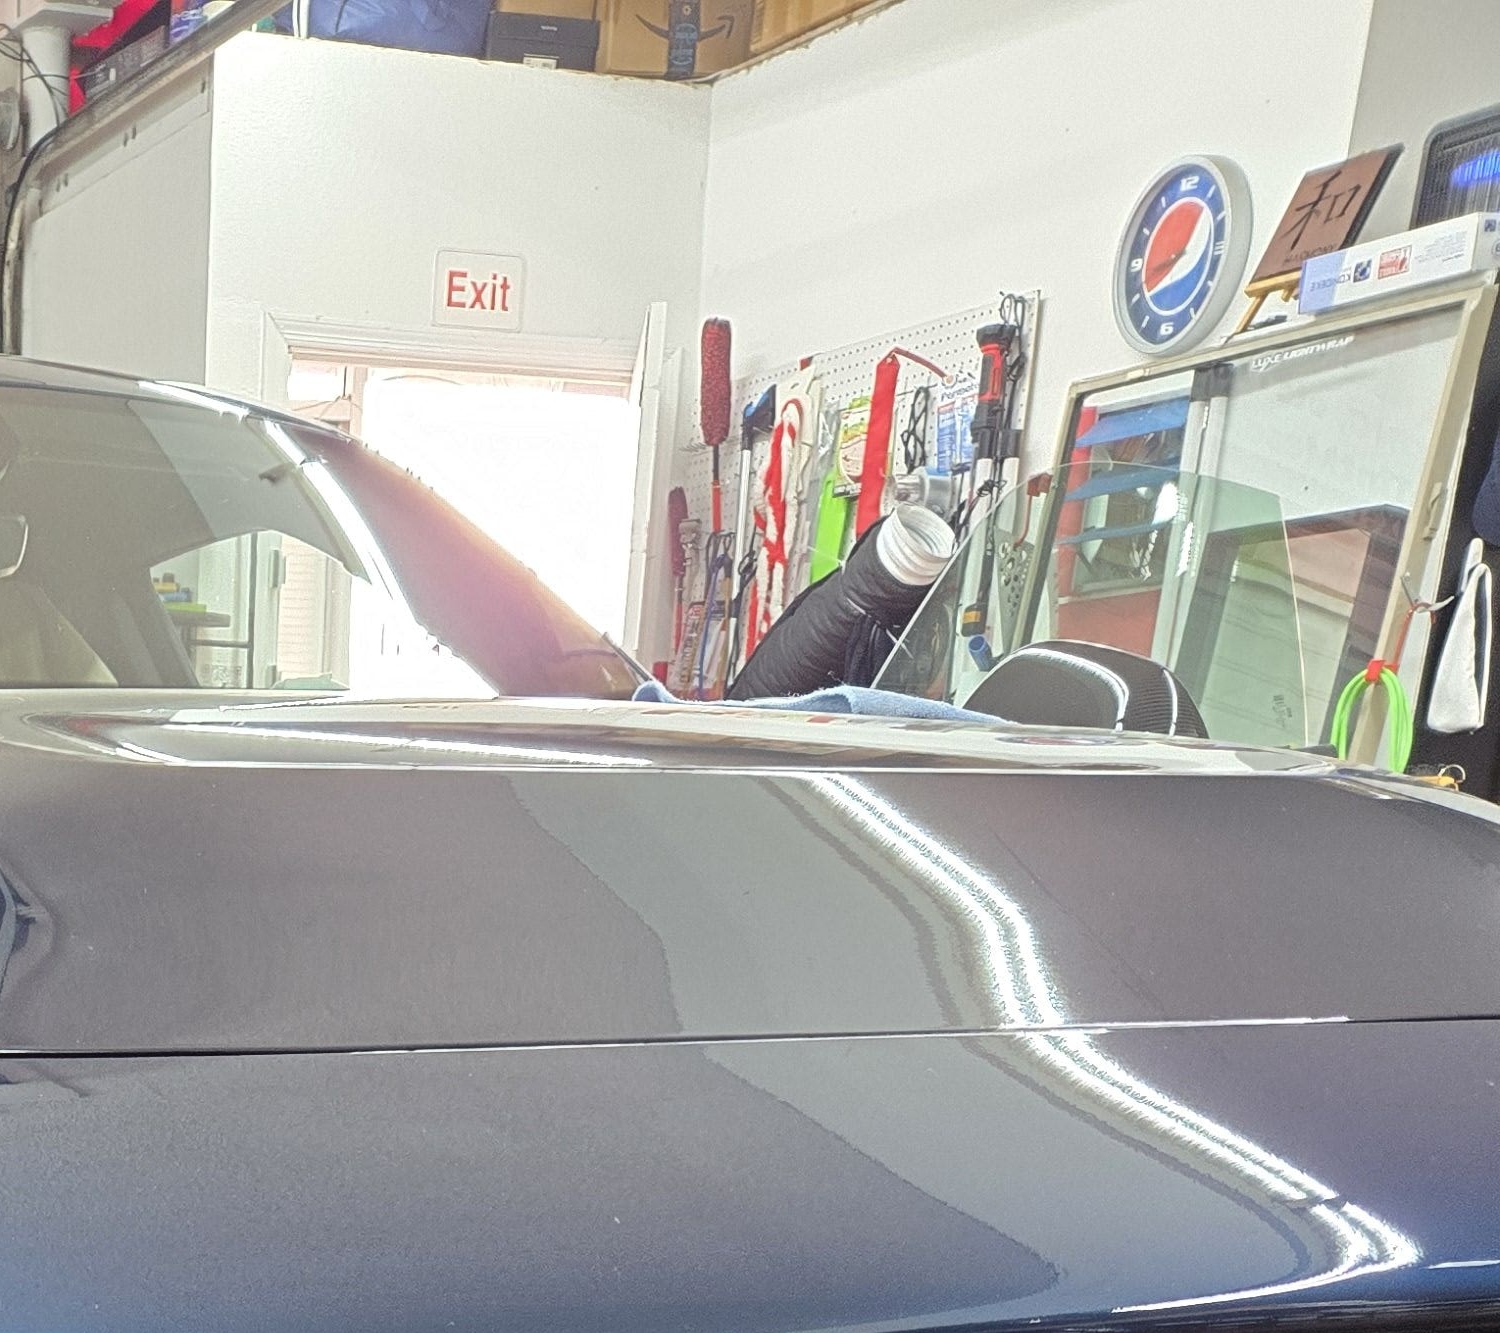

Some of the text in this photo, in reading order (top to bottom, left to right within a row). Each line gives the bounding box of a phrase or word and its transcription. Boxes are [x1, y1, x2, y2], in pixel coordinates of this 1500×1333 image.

[1179, 175, 1200, 191] 12
[1130, 258, 1143, 273] 9
[446, 270, 510, 312] Exit
[1159, 322, 1174, 336] 6
